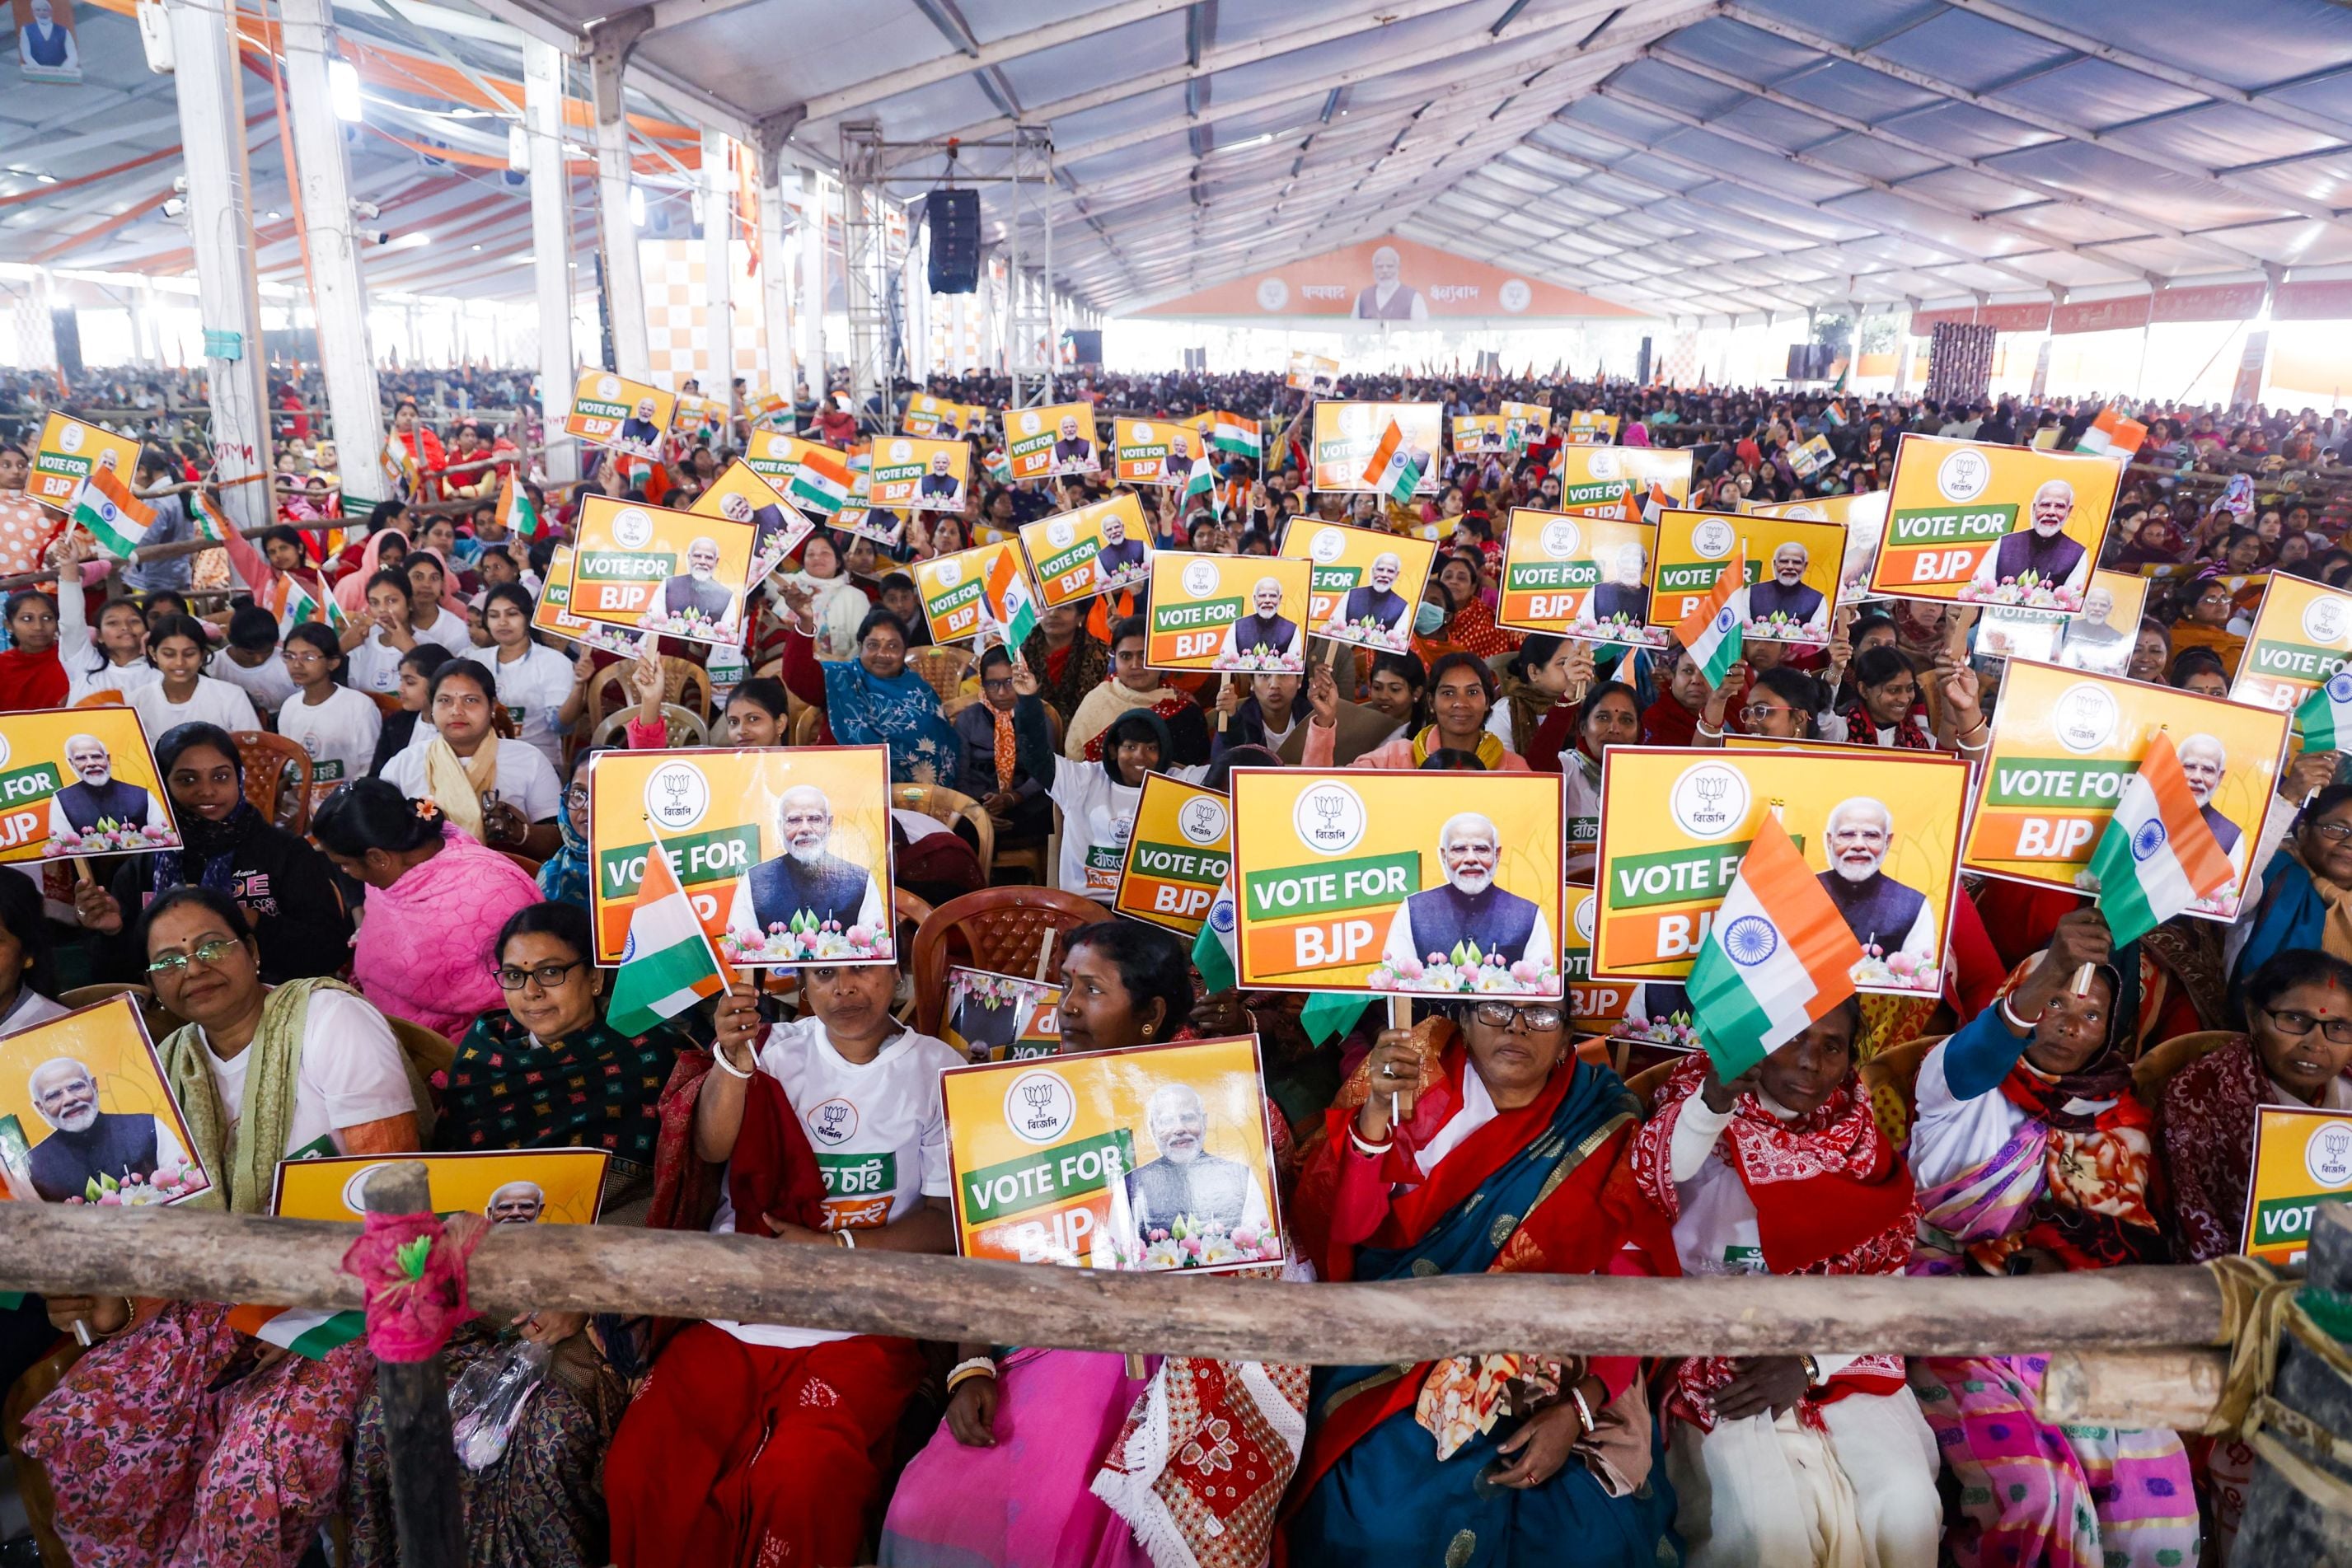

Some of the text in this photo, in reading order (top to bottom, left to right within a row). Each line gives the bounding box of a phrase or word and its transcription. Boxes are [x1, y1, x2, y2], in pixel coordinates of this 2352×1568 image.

[578, 400, 628, 418] VOTE FOR
[583, 419, 612, 435] BJP
[1013, 434, 1054, 455] VOTE FOR
[1122, 446, 1165, 458] VOTE FOR
[1321, 443, 1352, 458] VOT
[40, 456, 88, 475] VOTE FOR
[1025, 452, 1047, 471] BJP
[1134, 461, 1157, 475] BJP
[1337, 461, 1367, 481] BP
[874, 466, 923, 480] VOTE FOR
[43, 476, 72, 496] BJP
[885, 484, 911, 498] BJP
[1570, 487, 1603, 501] VOTE
[839, 511, 860, 522] BJP
[1897, 513, 2006, 538] VOTE FOR
[583, 558, 668, 576] VOTE FOR
[1041, 542, 1096, 577] VOTE FOR
[1912, 550, 1972, 582] BJP
[1061, 567, 1090, 594] BJP
[1322, 572, 1354, 587] FOR
[1513, 567, 1596, 584] VOTE FOR
[1663, 567, 1752, 586] VOTE FR
[551, 588, 568, 601] VO
[600, 586, 645, 610] BJP
[930, 583, 981, 614] VOTE FOR
[1158, 603, 1236, 626] VOTE FOR
[1529, 595, 1574, 618] BJP
[948, 606, 974, 632] BJP
[1176, 632, 1217, 658] BJP
[2260, 648, 2349, 676] VOTE FO
[2272, 684, 2312, 711] BJ
[3, 772, 54, 800] FOR
[1999, 770, 2076, 798] VOTE
[664, 807, 691, 816] বিজেপি
[1694, 812, 1726, 823] বিজেপি
[0, 812, 38, 847] JP
[1191, 826, 1211, 836] বিজেপি
[1316, 829, 1345, 840] বিজেপি
[1573, 818, 1598, 838] বাঁচ
[2015, 817, 2094, 858] BJP
[608, 839, 747, 887] VOE FOR
[1140, 849, 1229, 878] VOTE FO
[1088, 869, 1119, 887] বিজে
[1253, 866, 1408, 910] VOTE FOR
[1619, 859, 1709, 897] VOTE
[1154, 885, 1211, 915] BJP
[1295, 920, 1374, 967] BJP
[1656, 911, 1712, 957] BJ
[1564, 956, 1591, 975] OT
[818, 1126, 842, 1140] বিজেপি
[1028, 1117, 1057, 1130] বিজেপি
[840, 1158, 883, 1192] চাই
[971, 1145, 1123, 1211] VOTE FOR
[2322, 1163, 2346, 1174] বিজেপি
[2263, 1206, 2318, 1235] VOT
[1017, 1207, 1094, 1264] BJP
